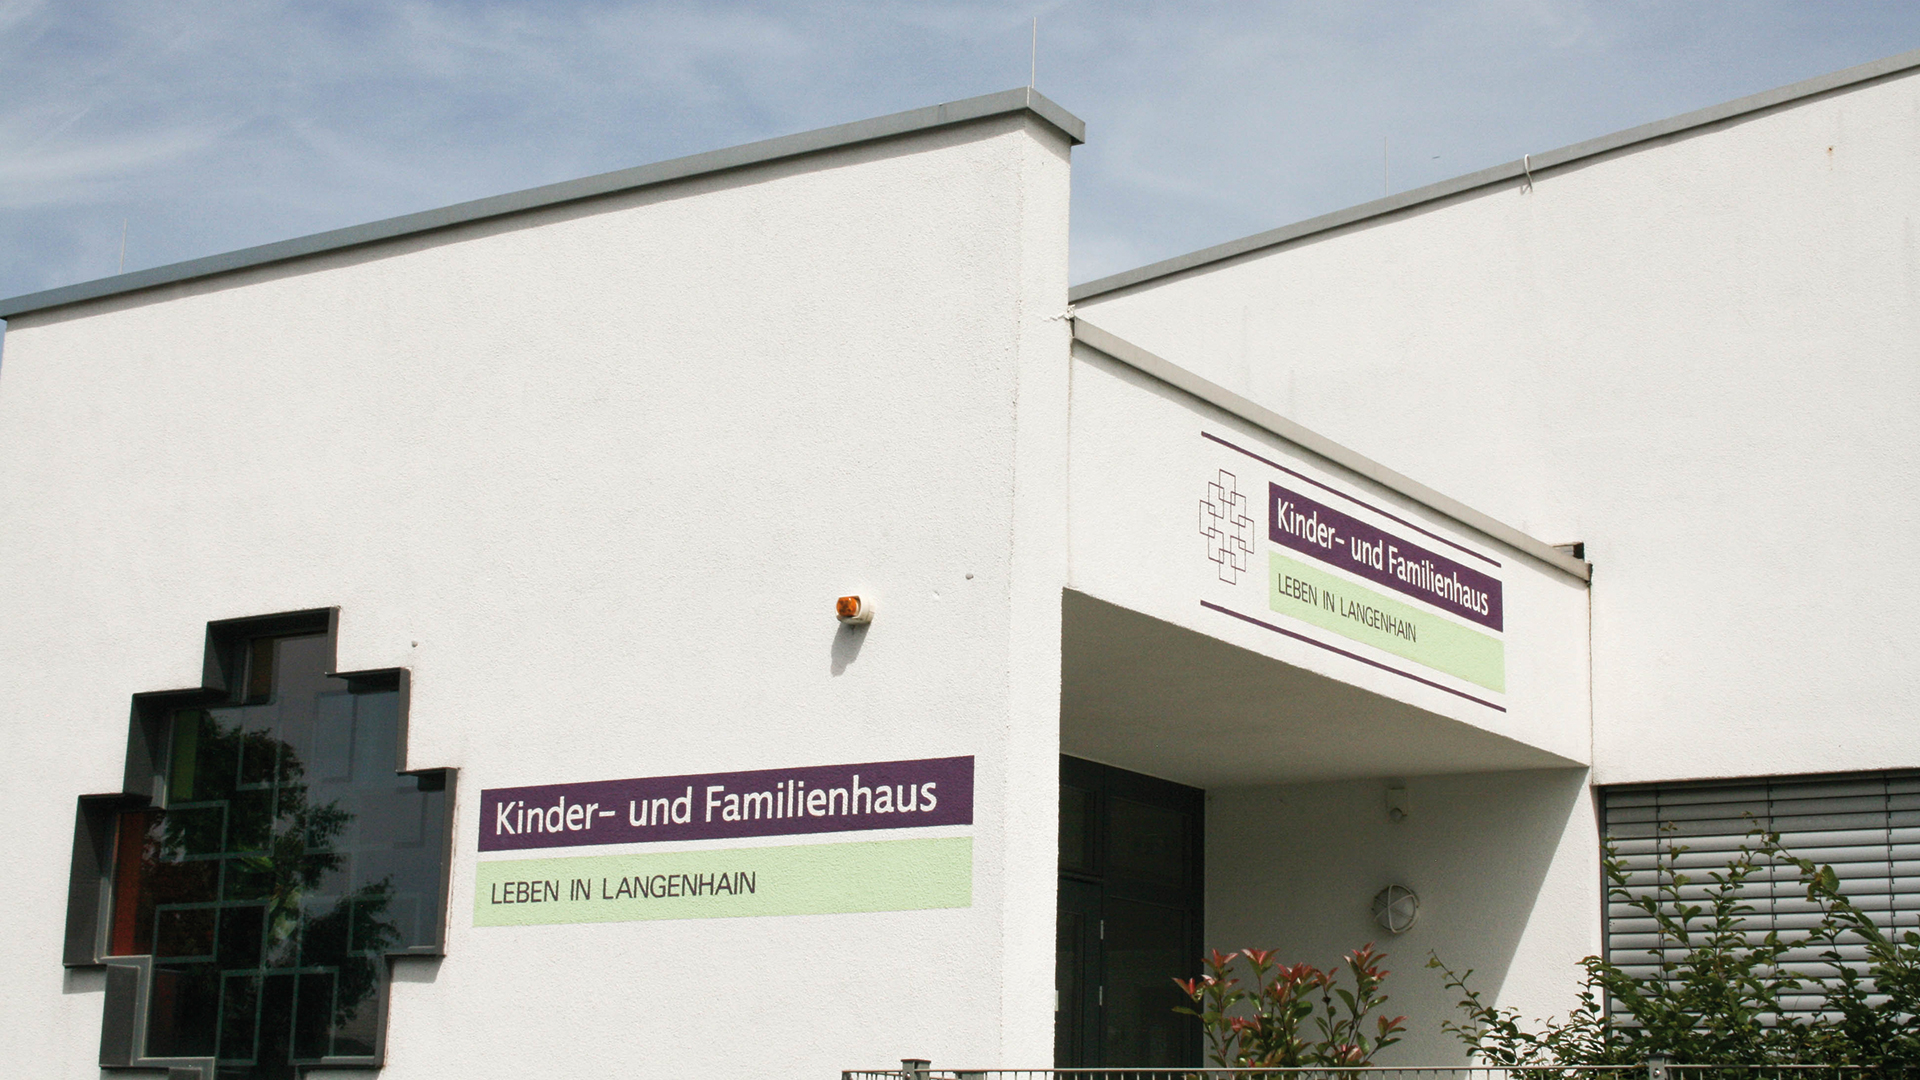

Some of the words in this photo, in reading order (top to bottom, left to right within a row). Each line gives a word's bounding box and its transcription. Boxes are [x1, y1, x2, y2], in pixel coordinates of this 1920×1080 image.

[1277, 498, 1345, 550] Kinder-
[1351, 536, 1383, 571] und
[1388, 545, 1489, 617] Familienhaus
[1278, 573, 1318, 606] LEBEN
[1323, 590, 1335, 613] IN
[1340, 596, 1417, 643] LANGENHAIN
[495, 796, 616, 836] Kinder-
[628, 787, 693, 827] und
[705, 775, 938, 823] Familienhaus
[491, 880, 560, 905] LEBEN
[570, 877, 591, 902] IN
[602, 871, 757, 900] LANGENHAIN
